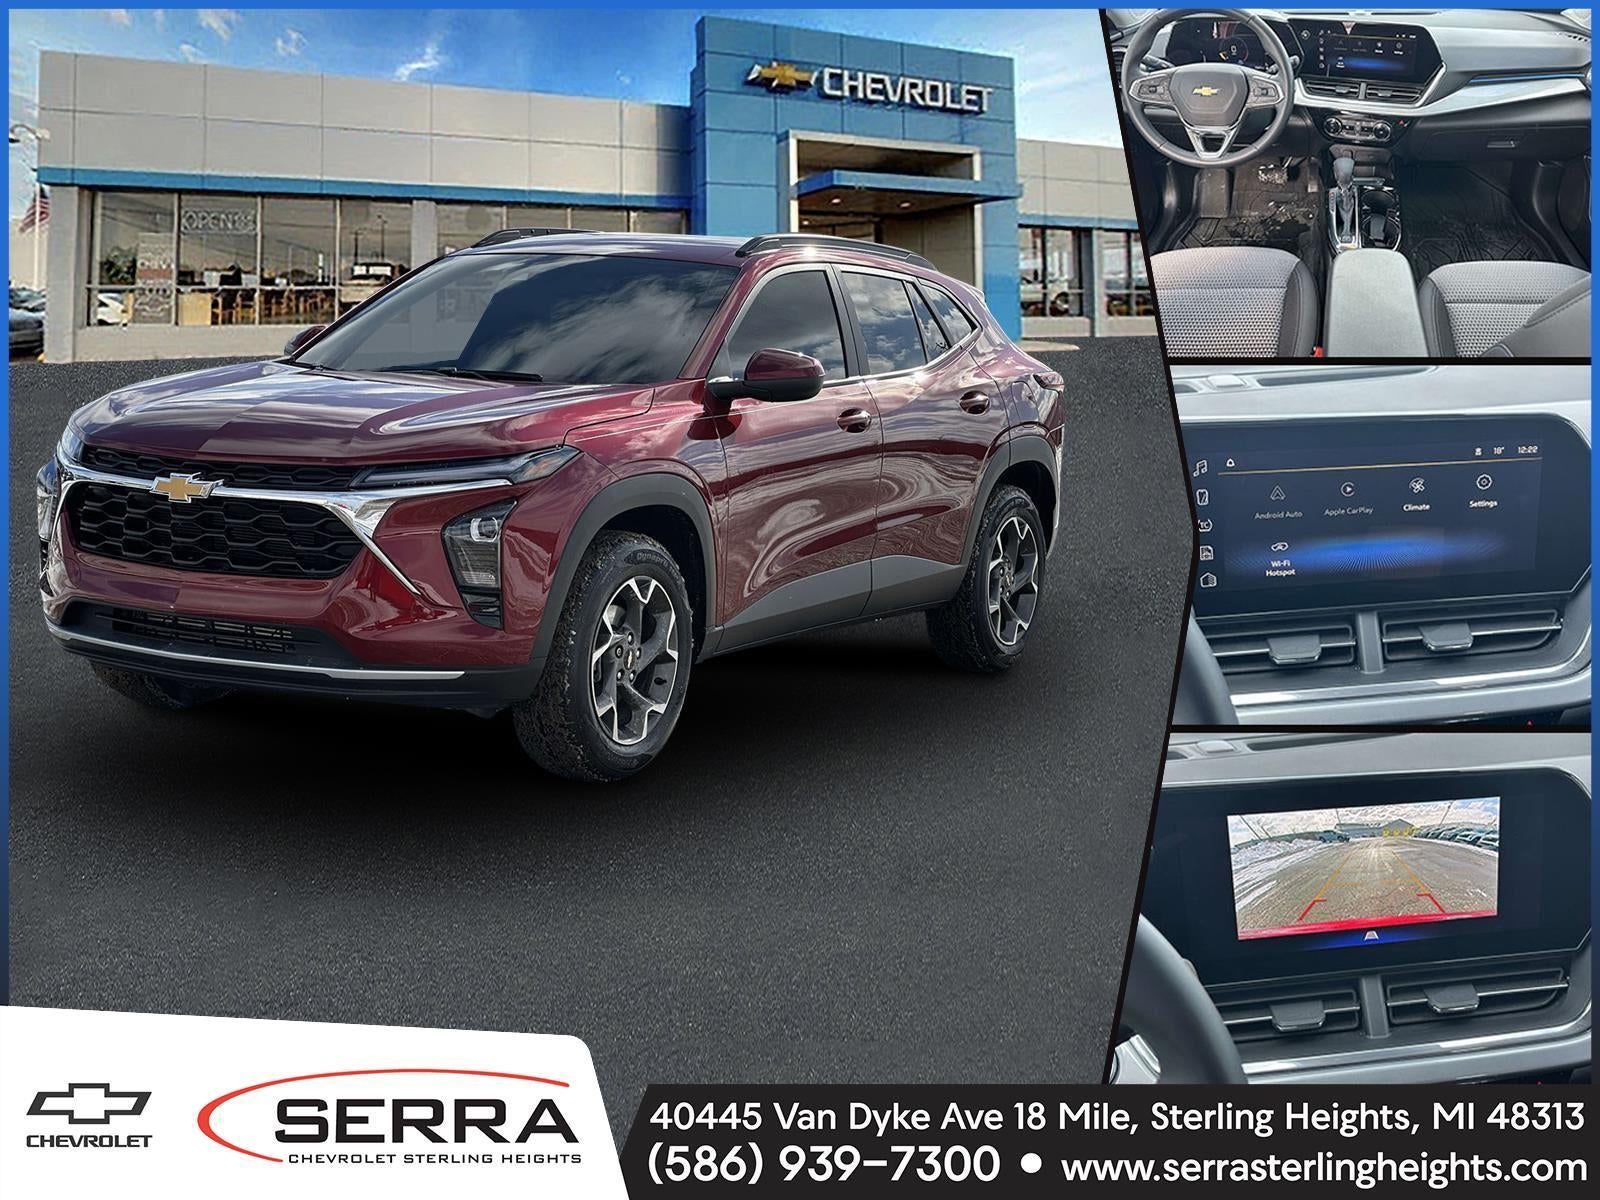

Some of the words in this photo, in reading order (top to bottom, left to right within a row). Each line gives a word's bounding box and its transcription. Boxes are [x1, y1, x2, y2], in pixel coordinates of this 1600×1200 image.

[822, 68, 993, 113] CHEVROLET
[1403, 503, 1430, 512] Climate
[1469, 499, 1498, 509] Settings
[1254, 511, 1284, 520] Android
[1285, 510, 1303, 519] Auto
[1324, 507, 1346, 517] Apple
[1347, 506, 1374, 516] CarPlay
[1271, 559, 1291, 568] Wi-Fi
[1265, 568, 1296, 578] Hotspot
